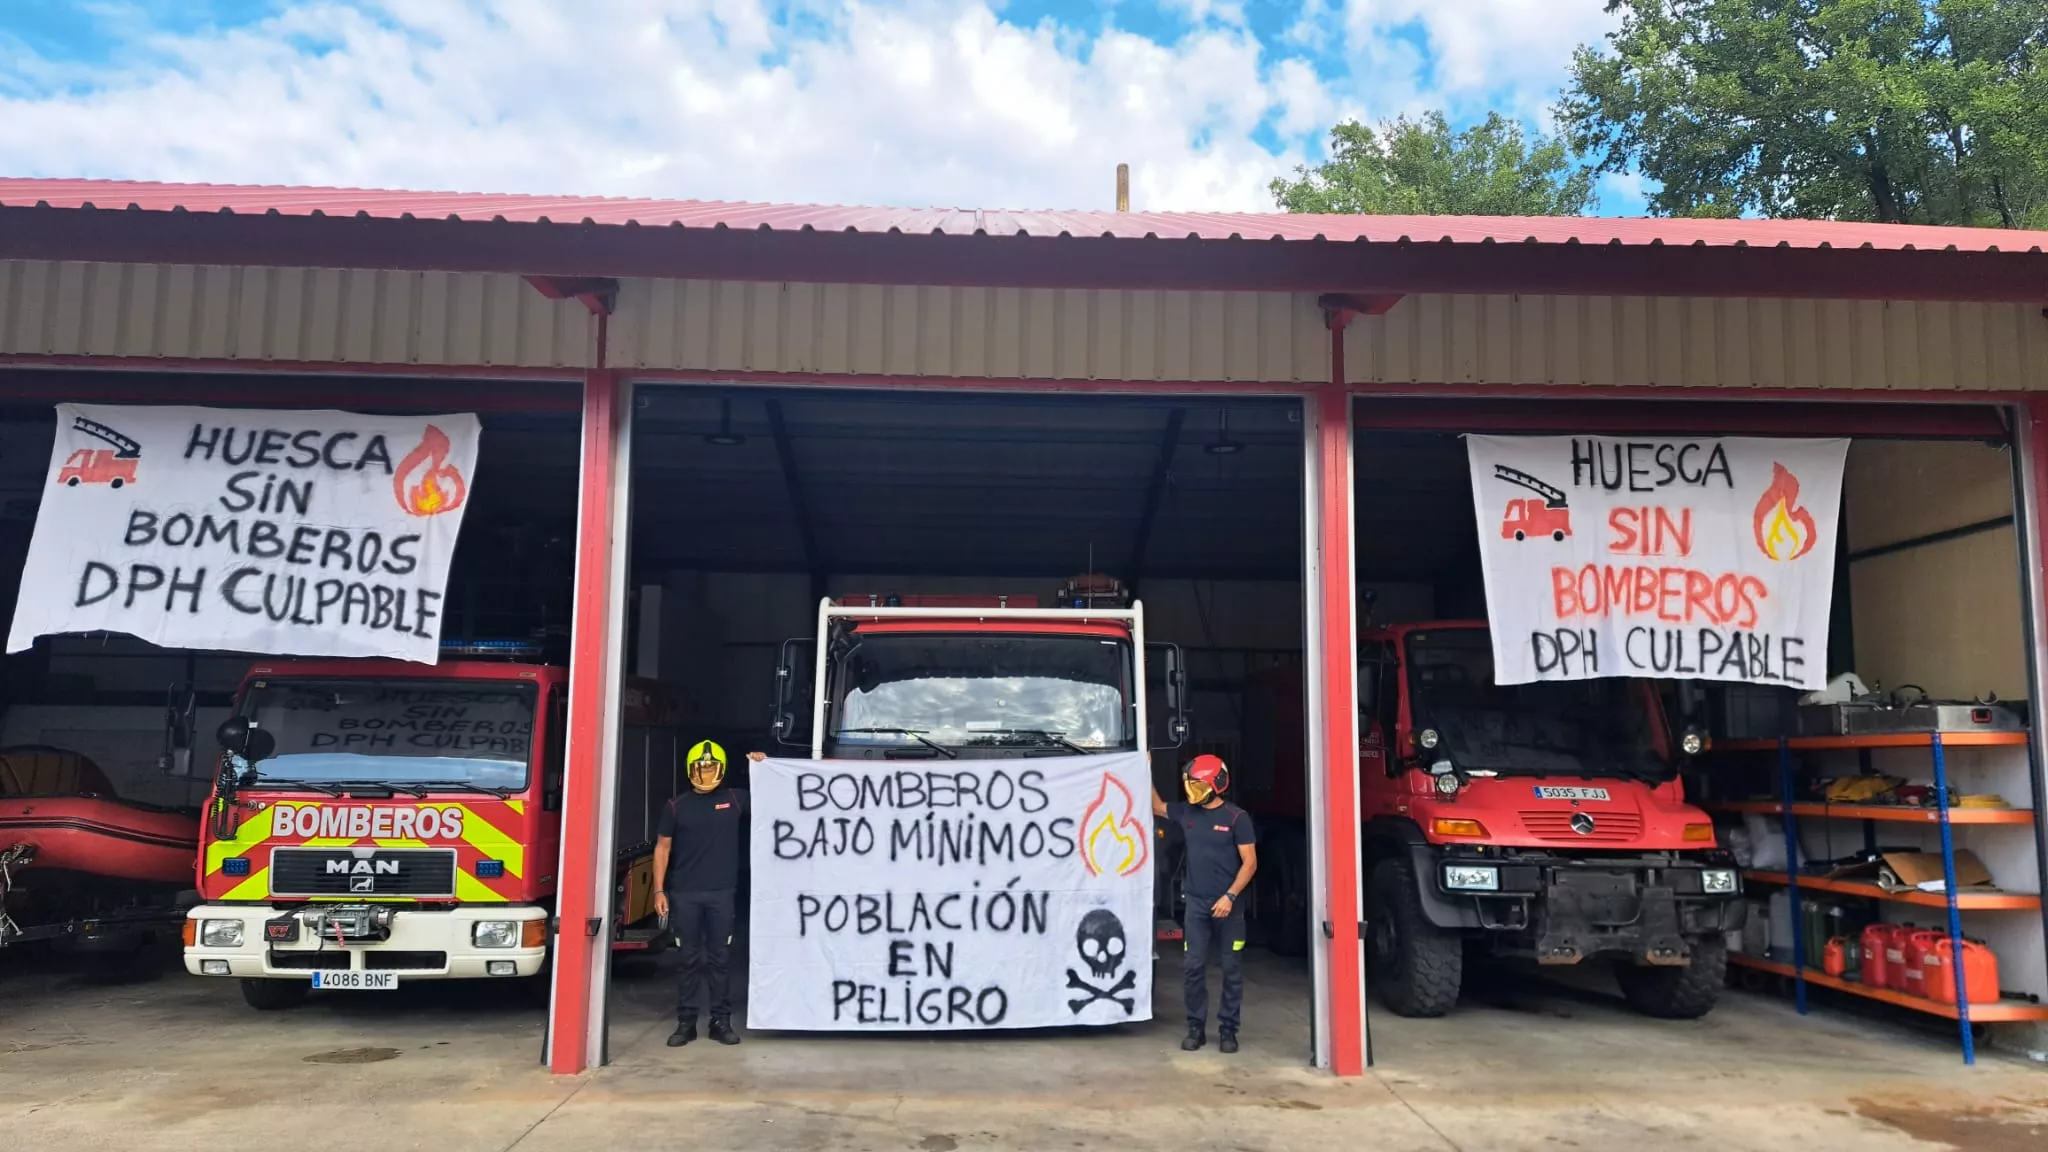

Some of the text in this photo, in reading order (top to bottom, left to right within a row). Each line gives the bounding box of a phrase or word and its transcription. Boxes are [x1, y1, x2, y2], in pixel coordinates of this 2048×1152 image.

[184, 423, 393, 475] HUESCA
[1571, 439, 1733, 492] HUESCA
[124, 508, 421, 575] BOMBEROS
[1608, 506, 1692, 557] SIN
[75, 561, 441, 639] DPH CULPABLE
[1551, 563, 1768, 629] BOMBEROS
[1531, 626, 1804, 684] DPH CULPABLE
[797, 770, 1049, 813] BOMBEROS
[1543, 787, 1606, 799] 5035 FJJ
[272, 805, 463, 839] BOMBEROS
[773, 817, 874, 860] BAJO
[326, 859, 399, 874] MAN
[323, 973, 392, 987] 4086 BNF
[888, 940, 954, 979] EN
